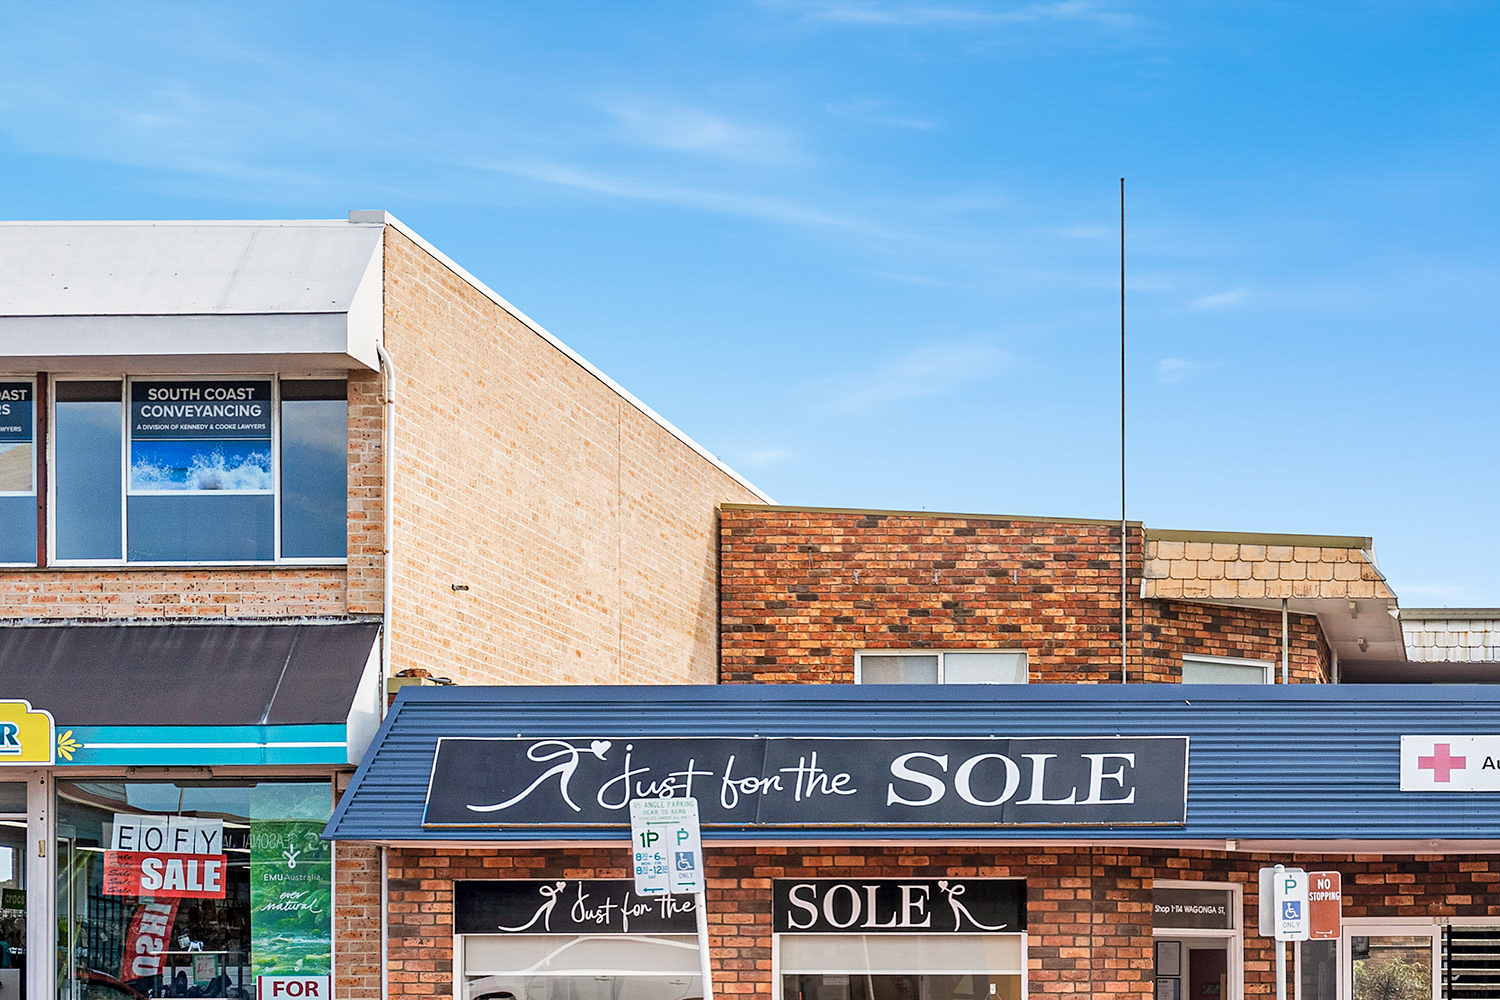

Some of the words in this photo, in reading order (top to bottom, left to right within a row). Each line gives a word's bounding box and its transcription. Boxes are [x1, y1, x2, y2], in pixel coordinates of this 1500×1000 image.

[0, 389, 28, 401] AST
[147, 388, 200, 401] SOUTH
[204, 387, 255, 401] COAST
[140, 404, 262, 417] CONVEYANCING
[721, 755, 784, 809] for
[779, 751, 858, 802] the
[886, 752, 1136, 806] SOLE
[667, 800, 695, 808] PARKING
[119, 825, 218, 854] EOFY
[640, 832, 659, 848] 1P
[677, 831, 689, 846] P
[141, 857, 221, 892] SALE
[264, 873, 284, 881] EMU
[1285, 879, 1297, 895] P
[1317, 878, 1331, 890] NO
[5, 893, 26, 906] crocs
[280, 890, 310, 900] ever
[1309, 891, 1340, 901] STOPPING
[621, 892, 652, 933] for
[654, 890, 697, 918] the
[787, 883, 932, 930] SOLE
[1154, 904, 1170, 914] Shop
[1184, 905, 1217, 914] WAGONGA
[273, 981, 319, 997] FOR
